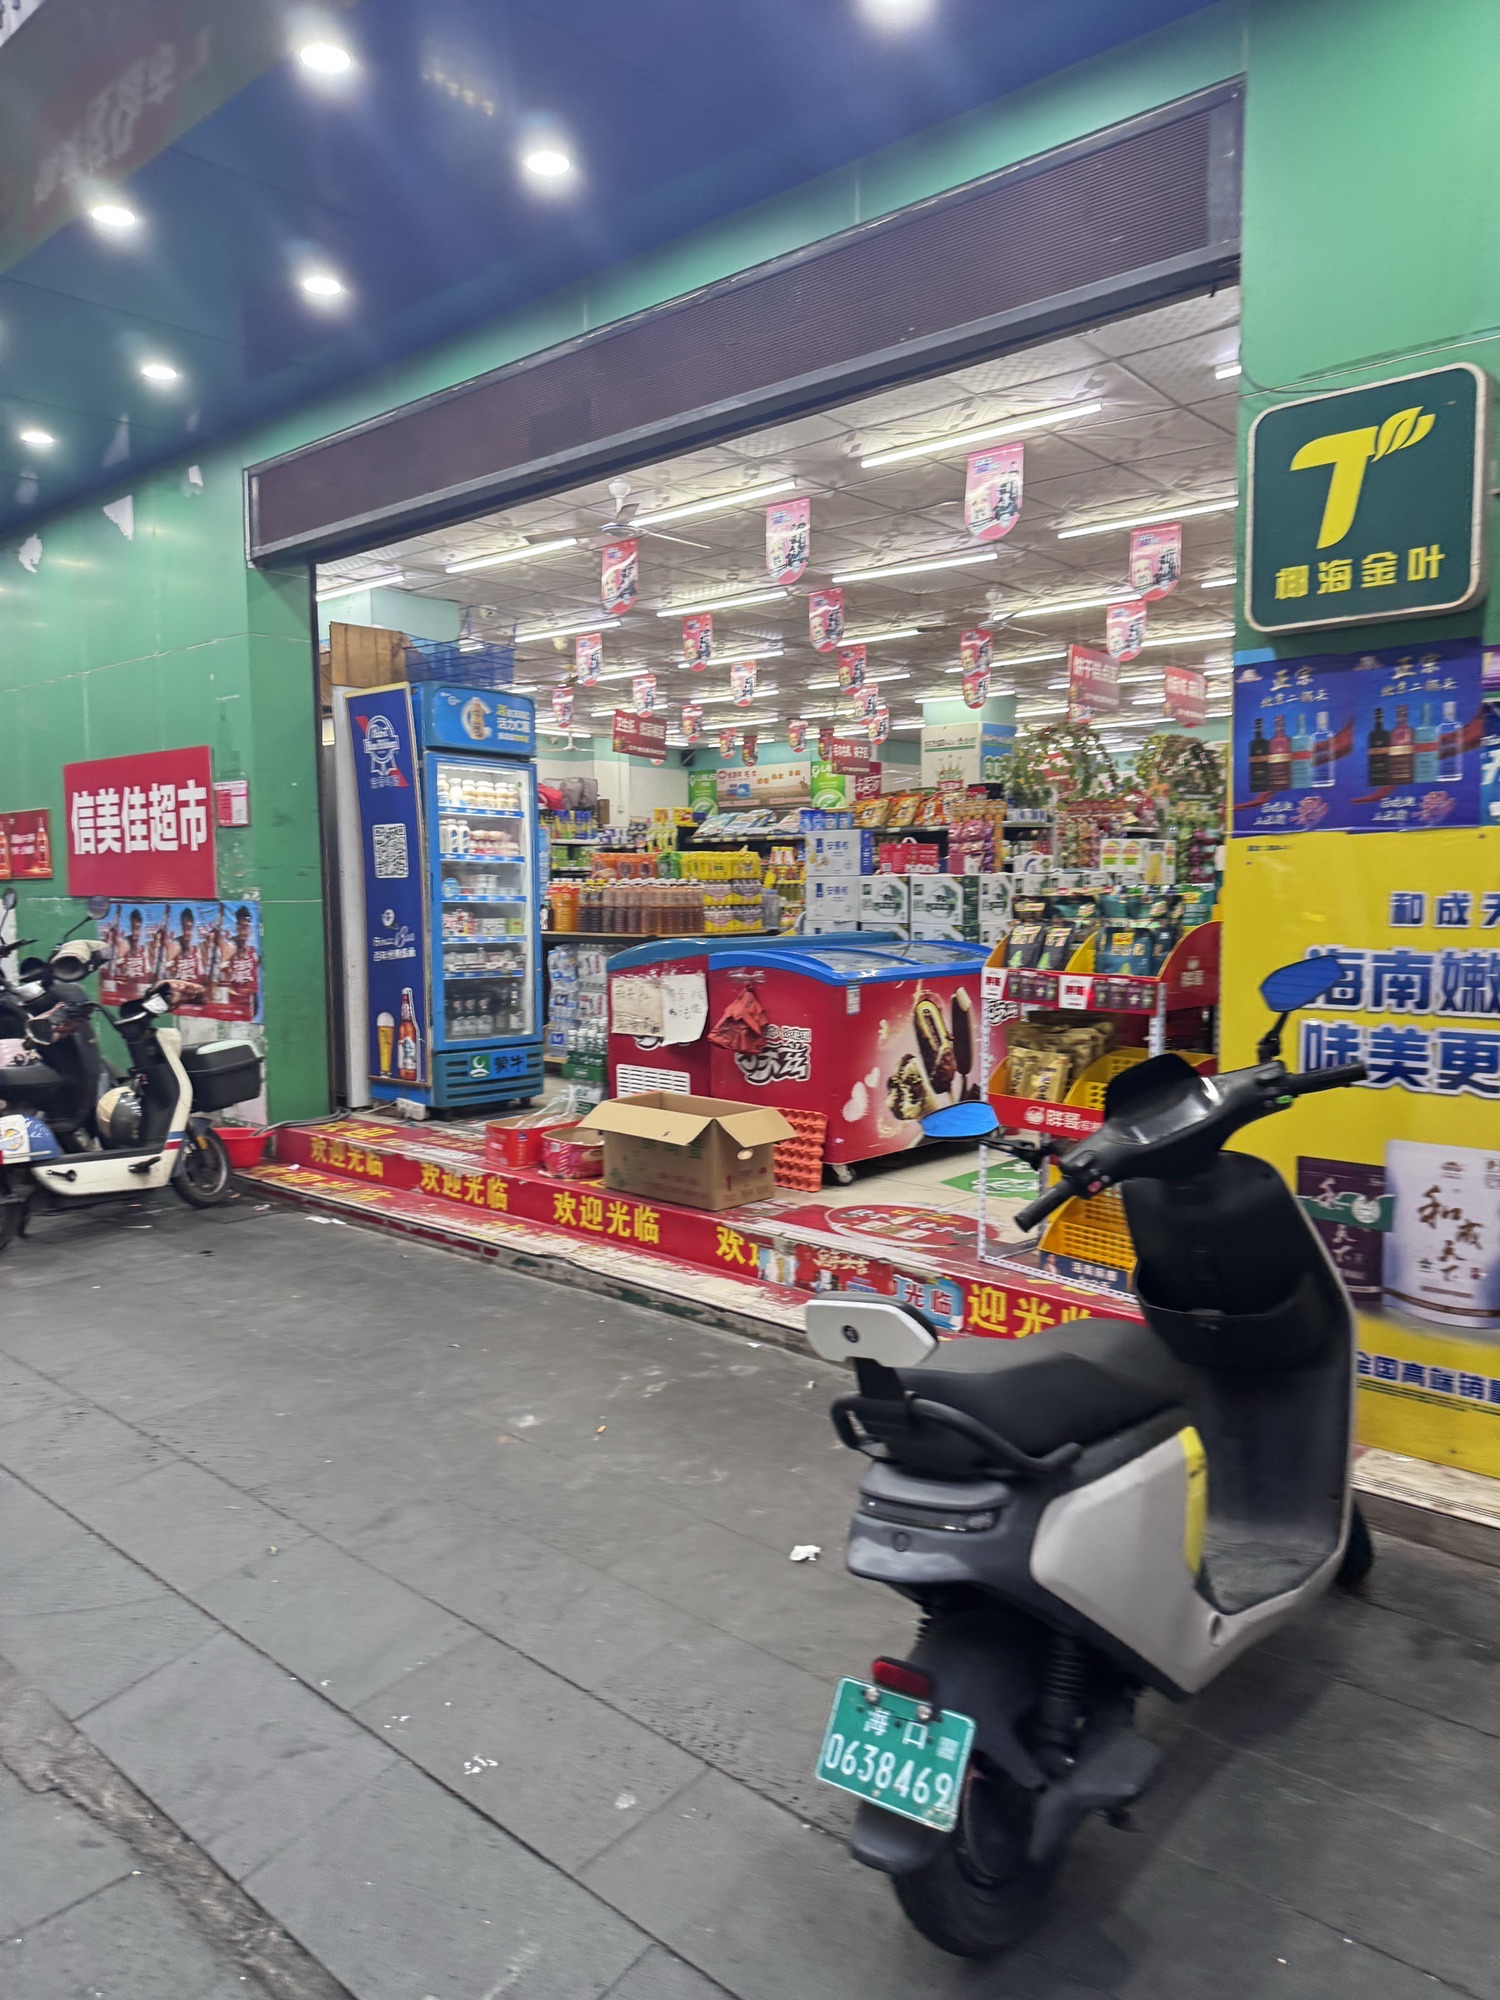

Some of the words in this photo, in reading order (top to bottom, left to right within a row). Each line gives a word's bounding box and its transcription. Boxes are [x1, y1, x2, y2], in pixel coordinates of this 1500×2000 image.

[1274, 545, 1446, 599] 椰海金叶
[71, 780, 208, 855] 信美佳超市
[311, 1136, 384, 1178] 欢迎光临
[420, 1162, 508, 1211] 欢迎光临
[553, 1190, 661, 1244] 欢迎光临
[863, 1706, 961, 1762] 海口
[825, 1733, 954, 1808] 0638469
